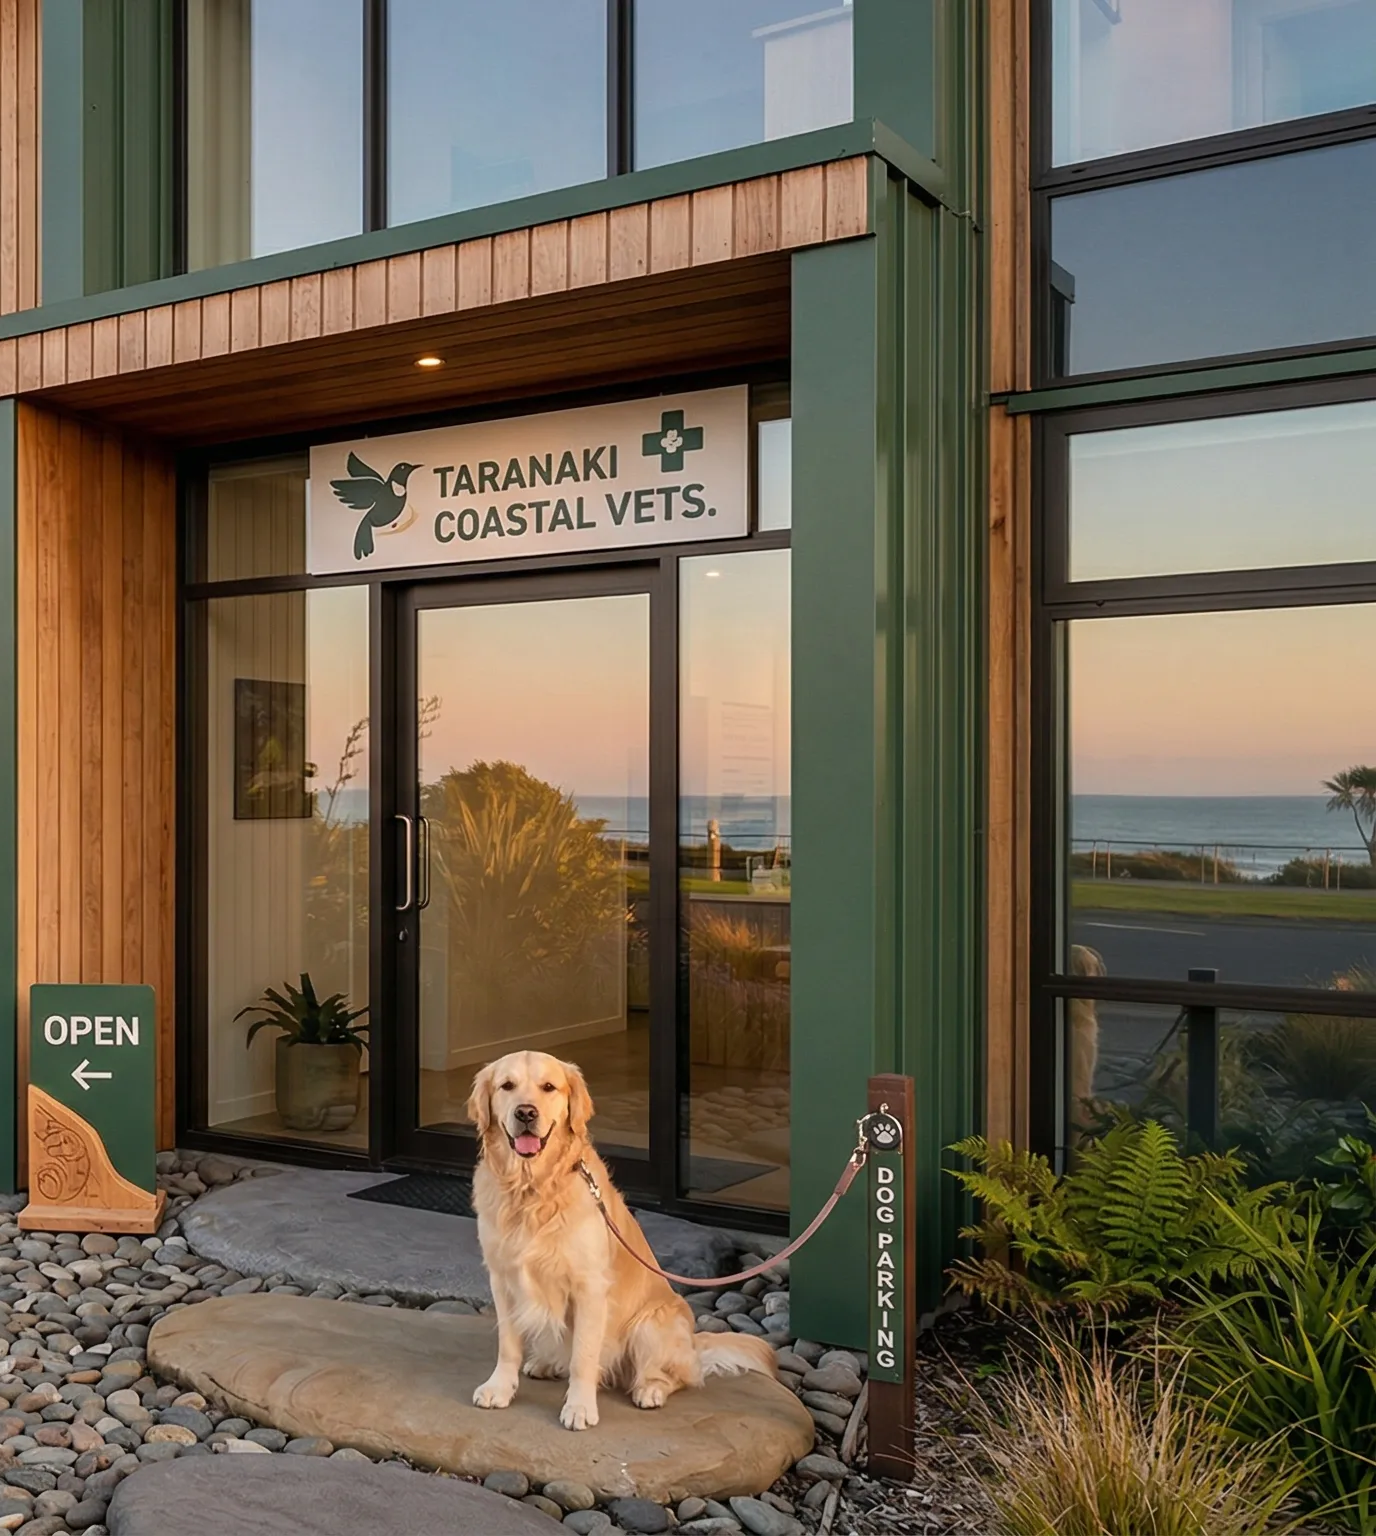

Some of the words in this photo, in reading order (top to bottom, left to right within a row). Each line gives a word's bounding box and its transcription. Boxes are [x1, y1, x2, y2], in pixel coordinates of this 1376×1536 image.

[432, 444, 618, 499] TARANAKI
[434, 496, 597, 544] COASTAL
[604, 483, 717, 526] VETS.
[44, 1015, 140, 1046] OPEN
[876, 1166, 895, 1224] DOG
[876, 1232, 895, 1369] PARKING
